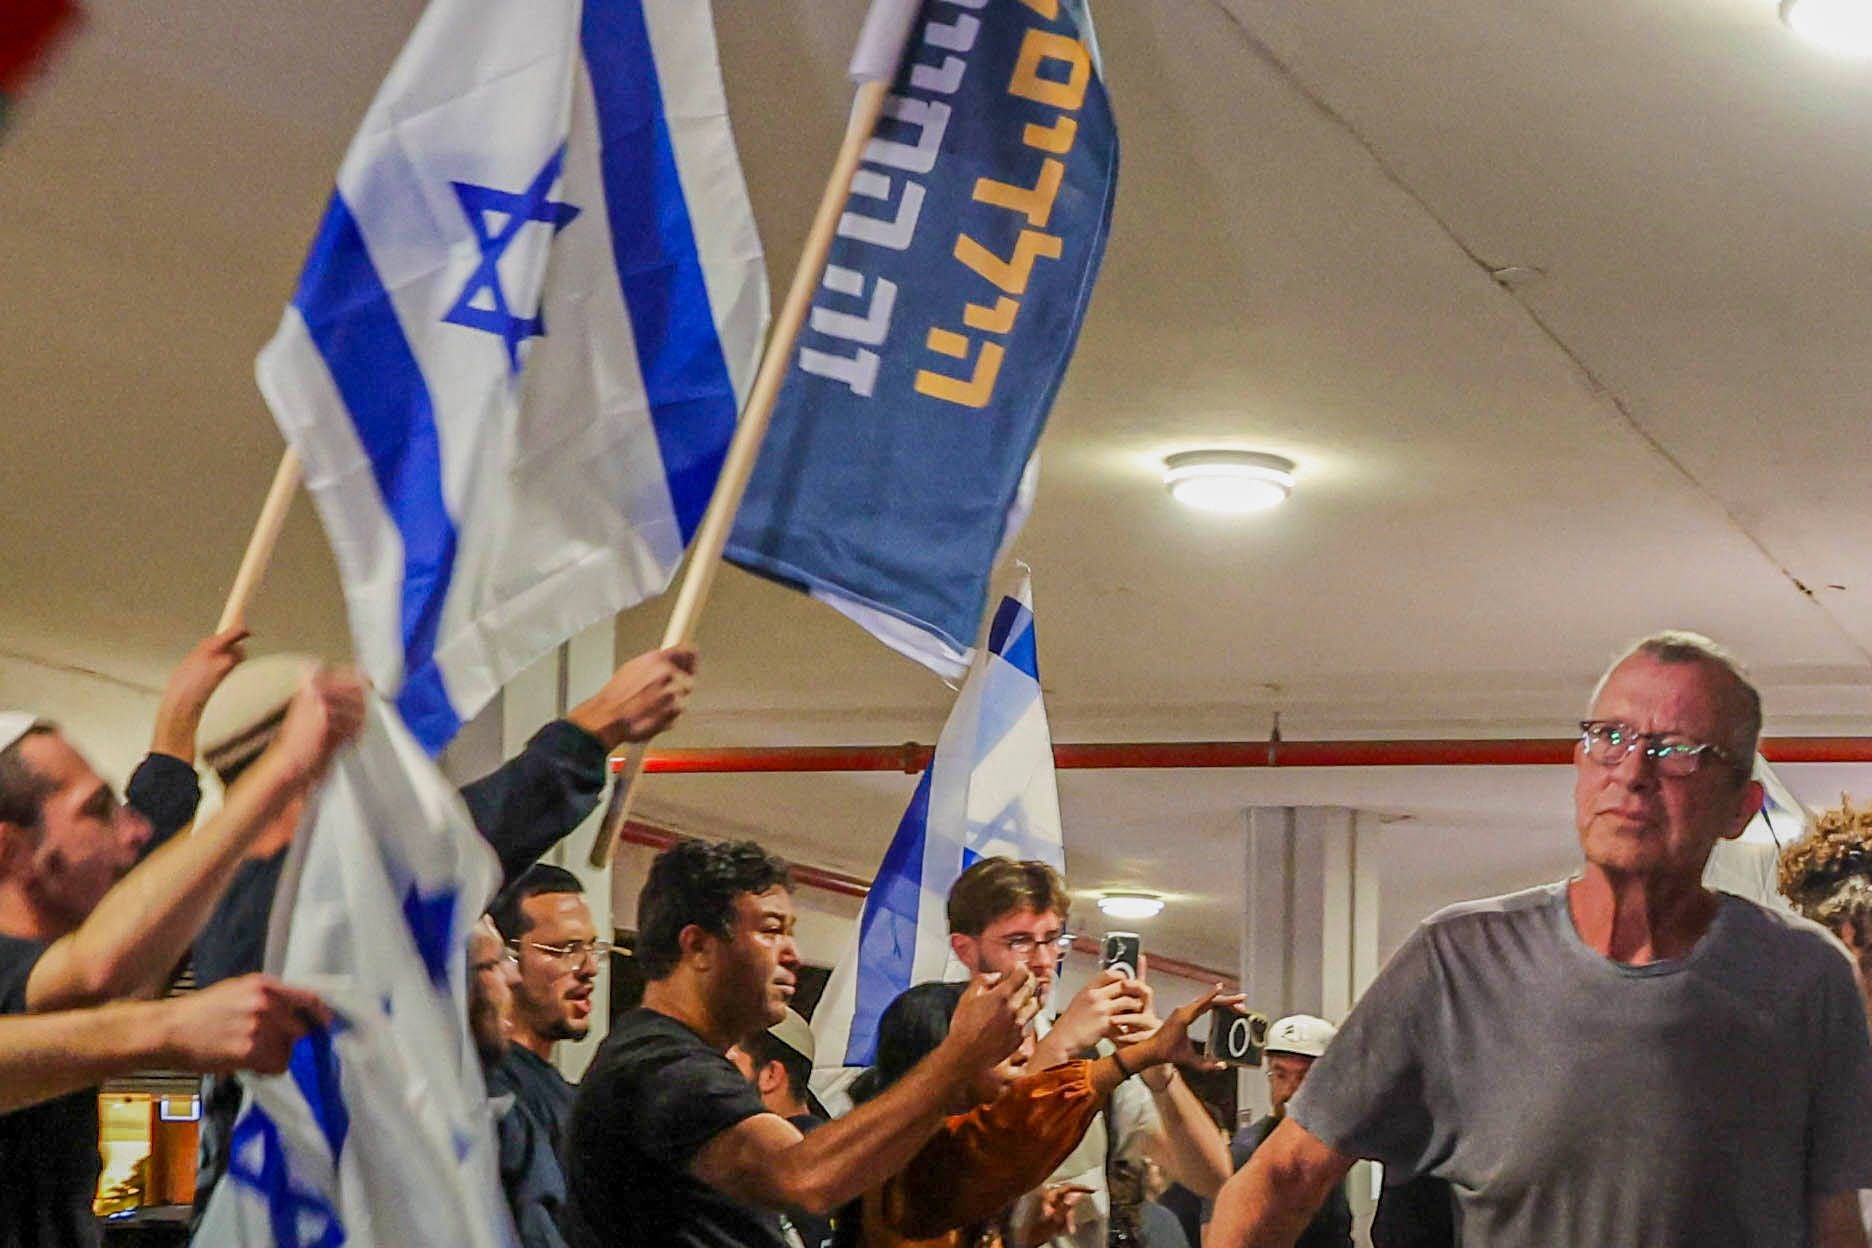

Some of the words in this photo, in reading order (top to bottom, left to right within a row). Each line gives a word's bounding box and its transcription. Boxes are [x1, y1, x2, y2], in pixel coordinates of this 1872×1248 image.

[837, 0, 988, 251] החיי
[913, 27, 1091, 409] הילדים
[798, 265, 898, 399] זה
